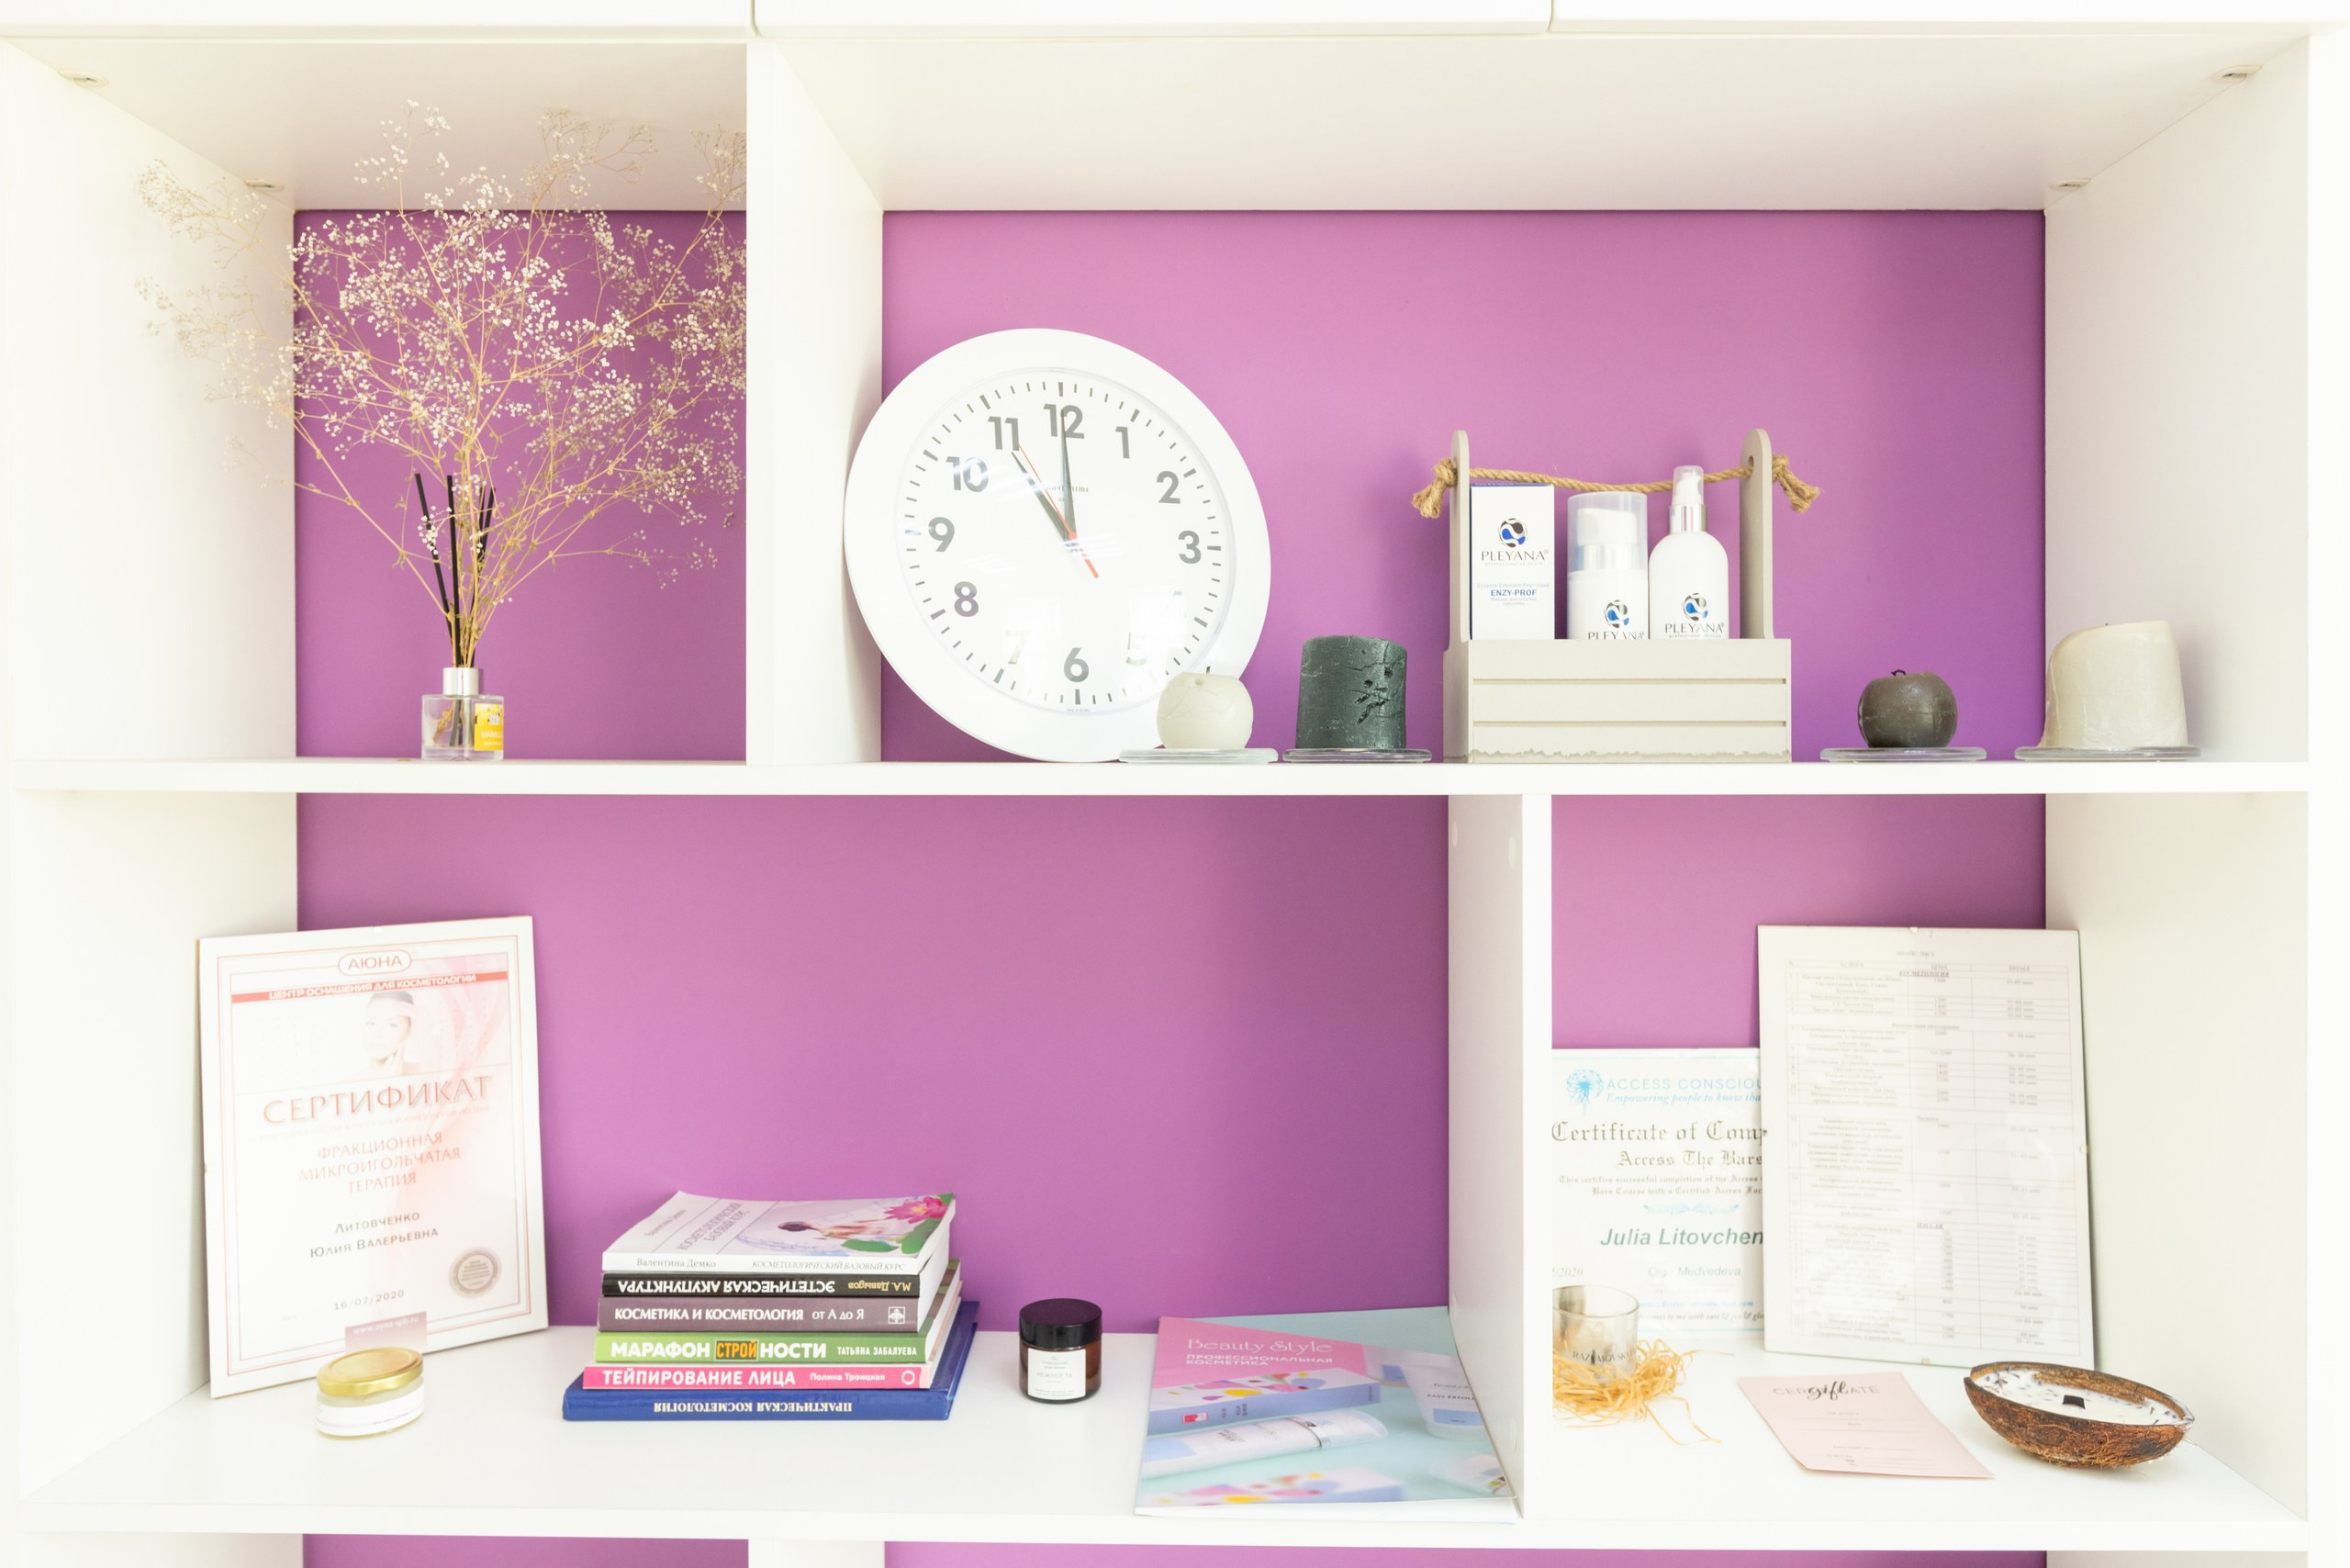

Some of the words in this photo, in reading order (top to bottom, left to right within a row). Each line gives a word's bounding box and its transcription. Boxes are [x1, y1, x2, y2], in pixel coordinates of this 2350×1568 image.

[1043, 404, 1085, 439] 12
[988, 416, 1020, 451] 11
[1115, 426, 1130, 459] 1
[946, 456, 989, 492] 10
[1156, 471, 1181, 504] 2
[928, 517, 955, 553] 9
[1178, 530, 1203, 565] 3
[954, 581, 979, 617] 8
[1665, 623, 1722, 633] PLEYANA
[1005, 630, 1029, 665] 7
[1063, 647, 1090, 683] 6
[347, 955, 403, 970] АЮНА
[1606, 1079, 1671, 1090] ACCESS
[263, 1075, 493, 1125] СЕРТИФИКАТ
[1606, 1092, 1670, 1105] Empowering
[1672, 1092, 1702, 1105] people
[1704, 1093, 1714, 1102] to
[1716, 1092, 1743, 1102] know
[1551, 1120, 1667, 1142] Certificate
[1676, 1121, 1698, 1140] of
[318, 1131, 442, 1159] ФРАКЦИОННАЯ
[299, 1148, 461, 1182] МИКРОИГОЛЬЧАТАЯ
[1616, 1150, 1675, 1167] Access
[1683, 1150, 1713, 1170] The
[348, 1172, 417, 1193] ТЕРАПИЯ
[1600, 1228, 1651, 1246] Julia
[1658, 1227, 1764, 1246] Litovchen
[636, 1258, 685, 1268] Валентина
[687, 1259, 717, 1269] Демко
[752, 1260, 844, 1271] КОСМЕТОЛОГИЧЕСКИЙ
[845, 1261, 883, 1271] БАЗОВЫЙ
[884, 1263, 905, 1271] КУРС
[1648, 1267, 1673, 1278] Olg
[1677, 1266, 1741, 1277] Medvedeva
[617, 1280, 721, 1294] АКУПУНКТУРА
[722, 1280, 835, 1294] ЭСТЕТИЧЕСКАЯ
[847, 1280, 890, 1292] Давыдов
[333, 1289, 405, 1311] 16/07/2020
[614, 1307, 689, 1320] КОСМЕТИКА
[692, 1308, 702, 1320] И
[705, 1308, 804, 1321] КОСМЕТОЛОГИЯ
[827, 1308, 837, 1320] А
[856, 1308, 865, 1320] Я
[610, 1341, 711, 1359] МАРАФОН
[837, 1346, 870, 1356] ТАТЬЯНА
[873, 1346, 917, 1356] ЗАБАЛУЕВА
[1187, 1338, 1267, 1353] Beauty
[1270, 1340, 1333, 1355] Style
[1186, 1354, 1333, 1363] ПРОФЕССИОНАЛЬНАЯ
[602, 1368, 744, 1385] ТЕЙПИРОВАНИЕ
[748, 1370, 796, 1387] ЛИЦА
[810, 1372, 843, 1383] Полина
[845, 1372, 886, 1383] Троицкая
[1807, 1381, 1849, 1401] gift
[654, 1402, 753, 1413] КОСМЕТОЛОГИЯ
[756, 1402, 853, 1413] ПРАКТИЧЕСКАЯ
